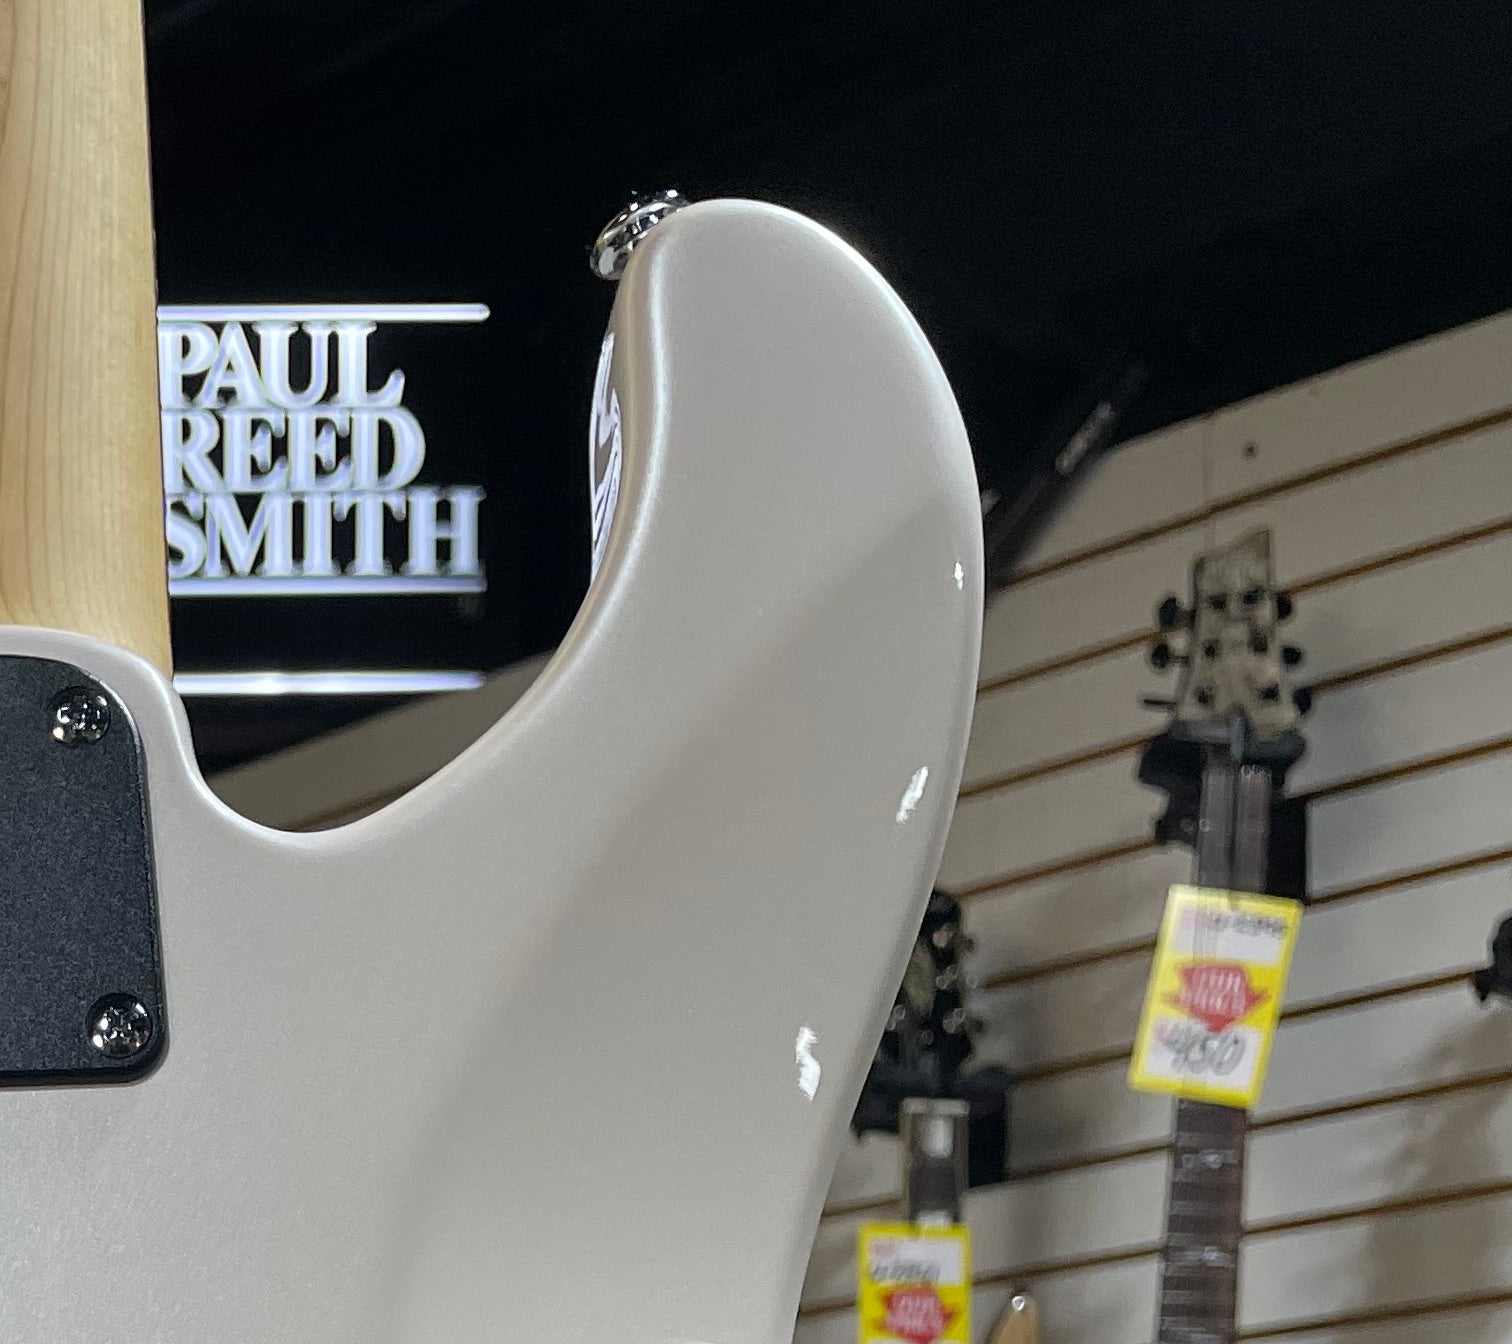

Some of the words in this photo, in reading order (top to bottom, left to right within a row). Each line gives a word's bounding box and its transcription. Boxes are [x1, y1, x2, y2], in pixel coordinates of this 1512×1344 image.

[157, 321, 405, 411] PAUL
[161, 406, 426, 494] REED
[166, 486, 487, 577] SMITH
